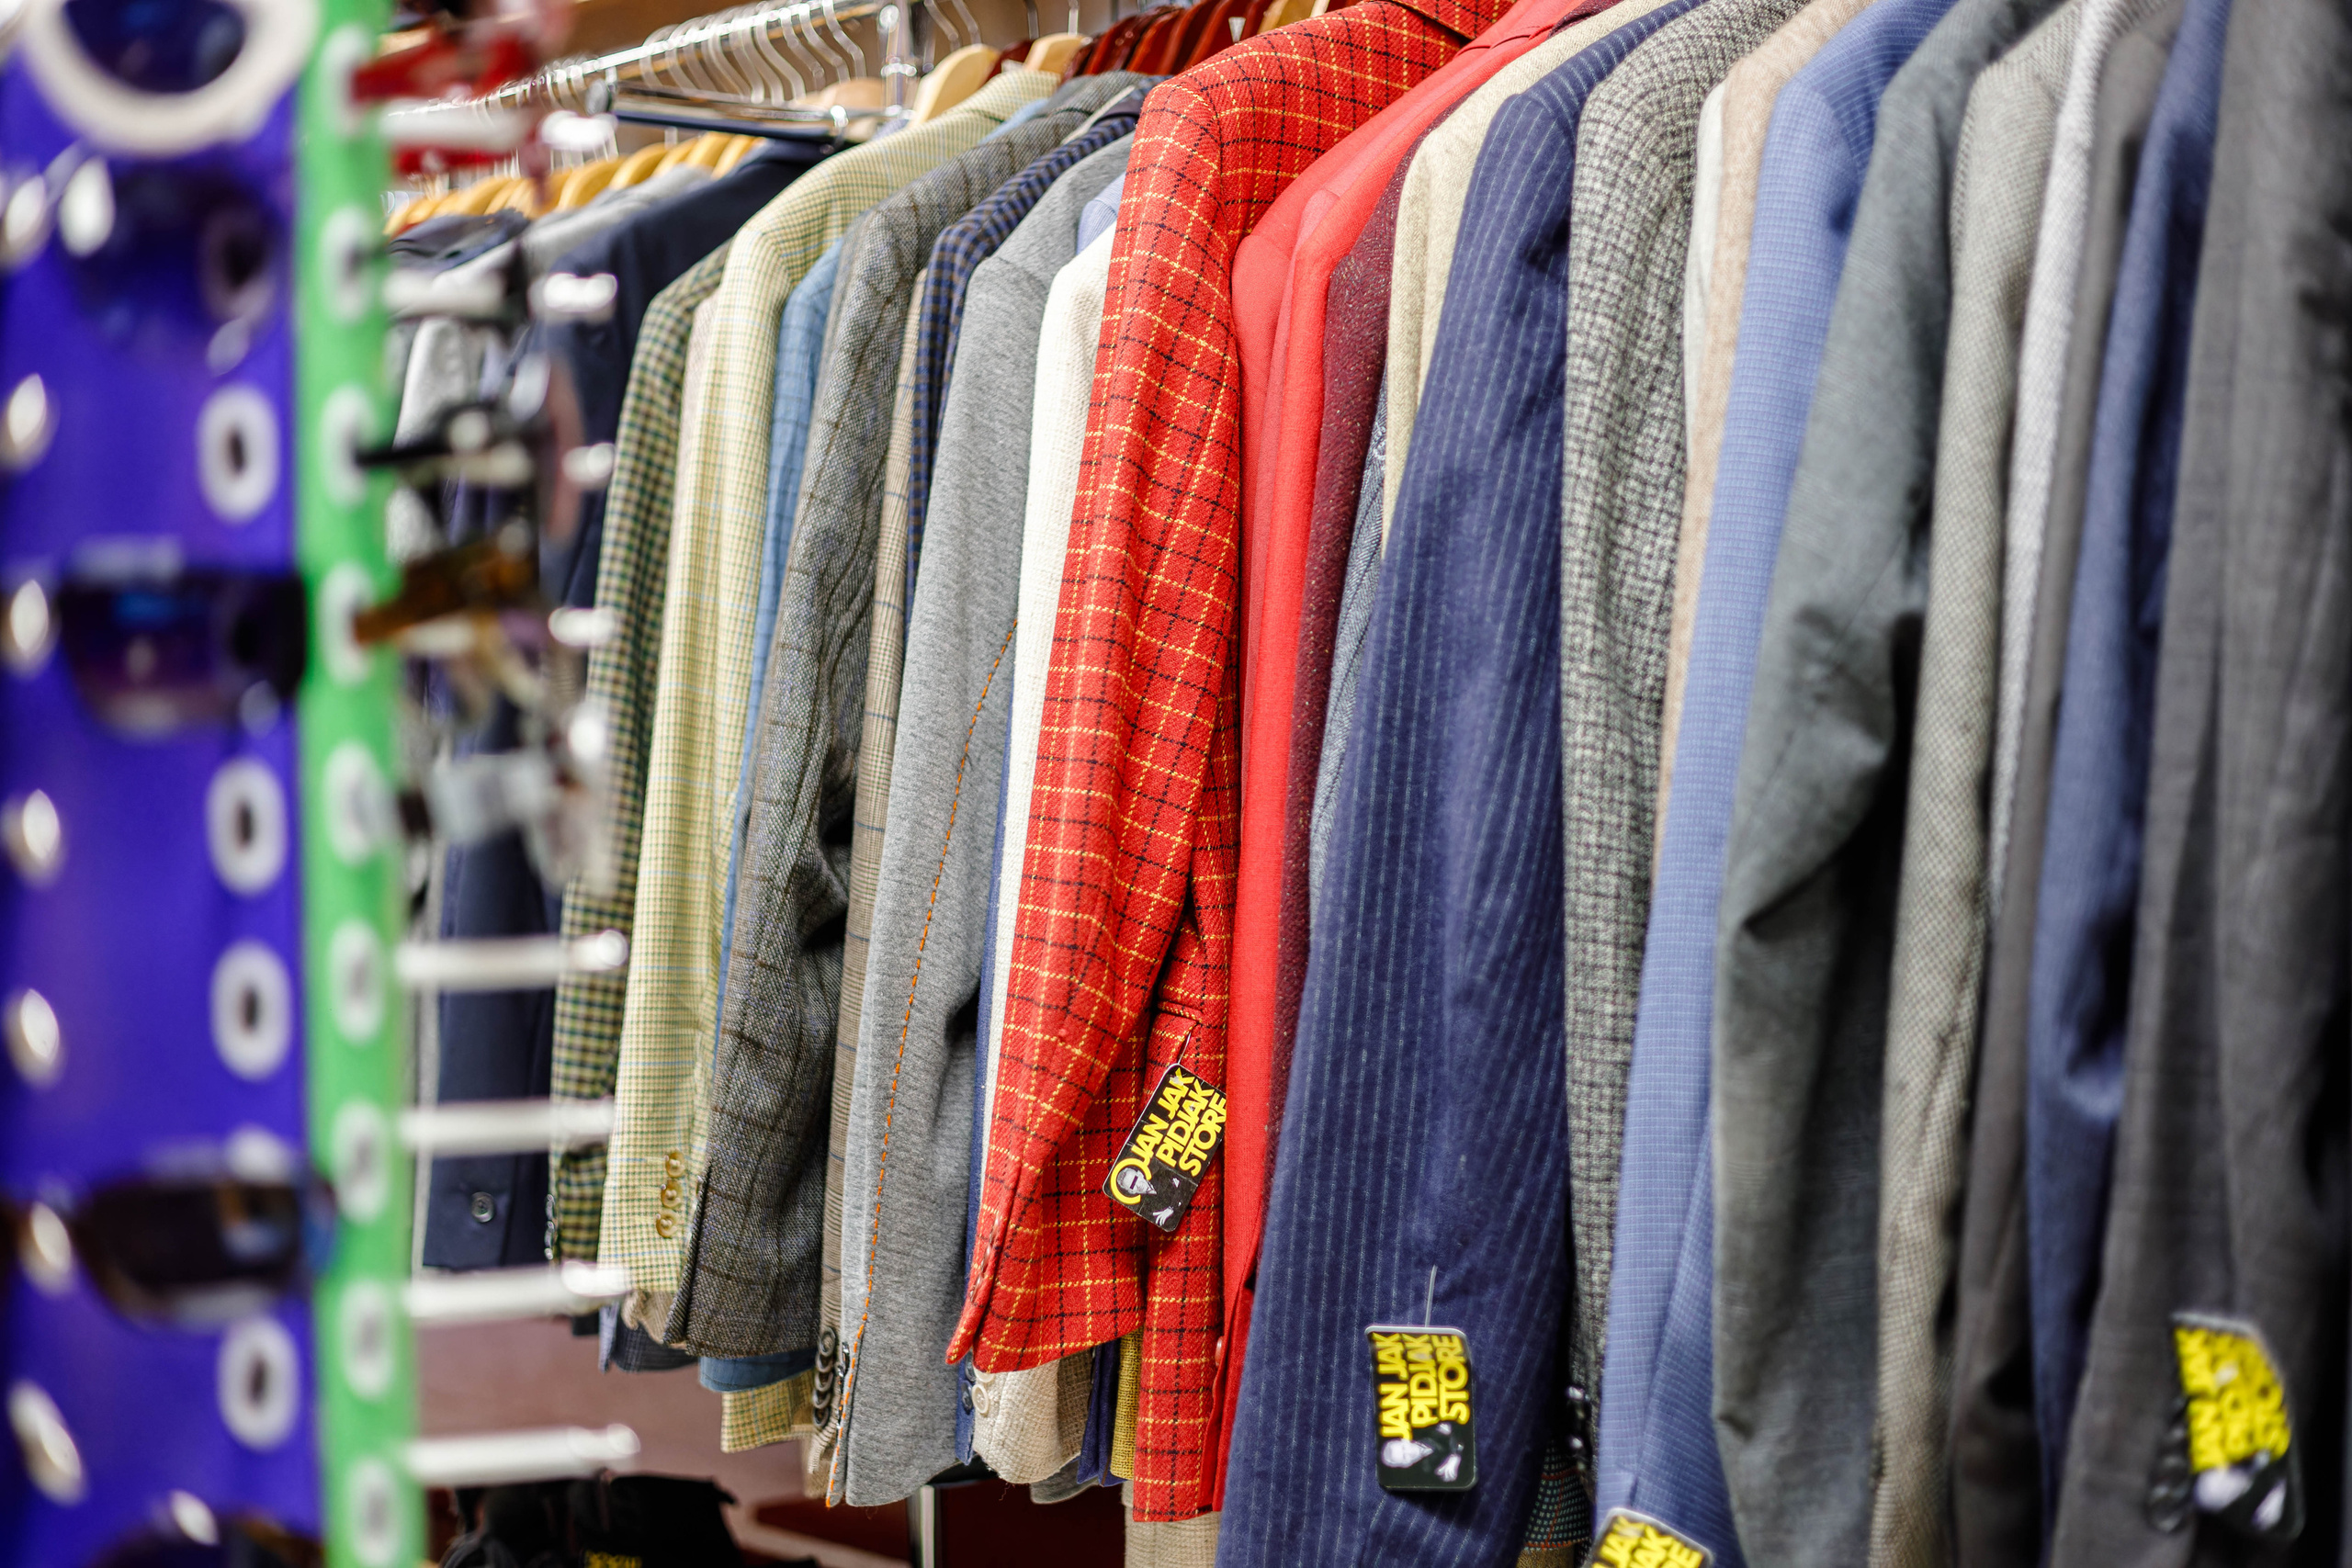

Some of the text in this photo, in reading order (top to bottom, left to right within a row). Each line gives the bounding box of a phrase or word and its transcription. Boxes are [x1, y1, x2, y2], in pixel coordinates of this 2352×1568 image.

[1156, 1079, 1215, 1168] PIDJAK
[1158, 1067, 1195, 1120] JAK
[1179, 1093, 1227, 1177] STORE
[1372, 1332, 1413, 1441] JAN JAK
[1402, 1333, 1440, 1428] PIDJAK
[1430, 1334, 1470, 1425] STORE
